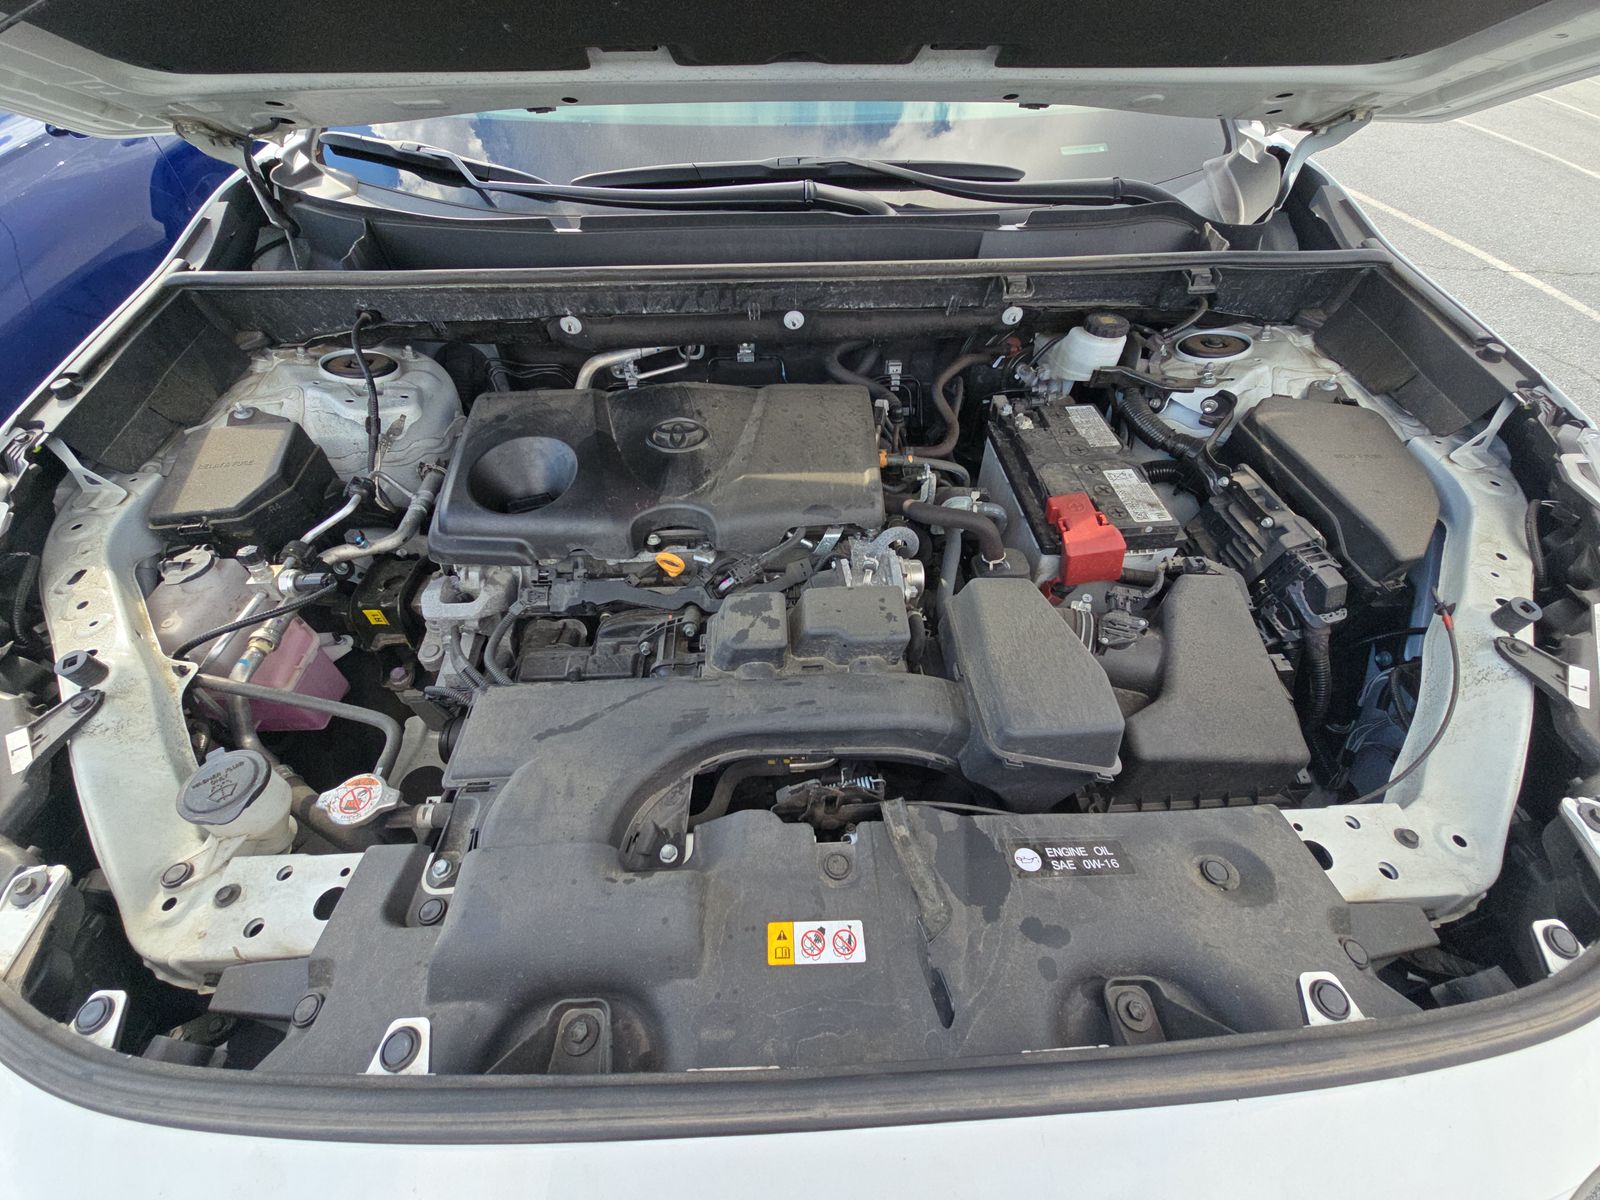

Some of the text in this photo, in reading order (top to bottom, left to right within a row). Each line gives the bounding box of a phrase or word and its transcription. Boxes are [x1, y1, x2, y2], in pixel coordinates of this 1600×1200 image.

[1044, 846, 1114, 858] ENGINE OIL
[1051, 858, 1120, 871] SAE 0W-16
